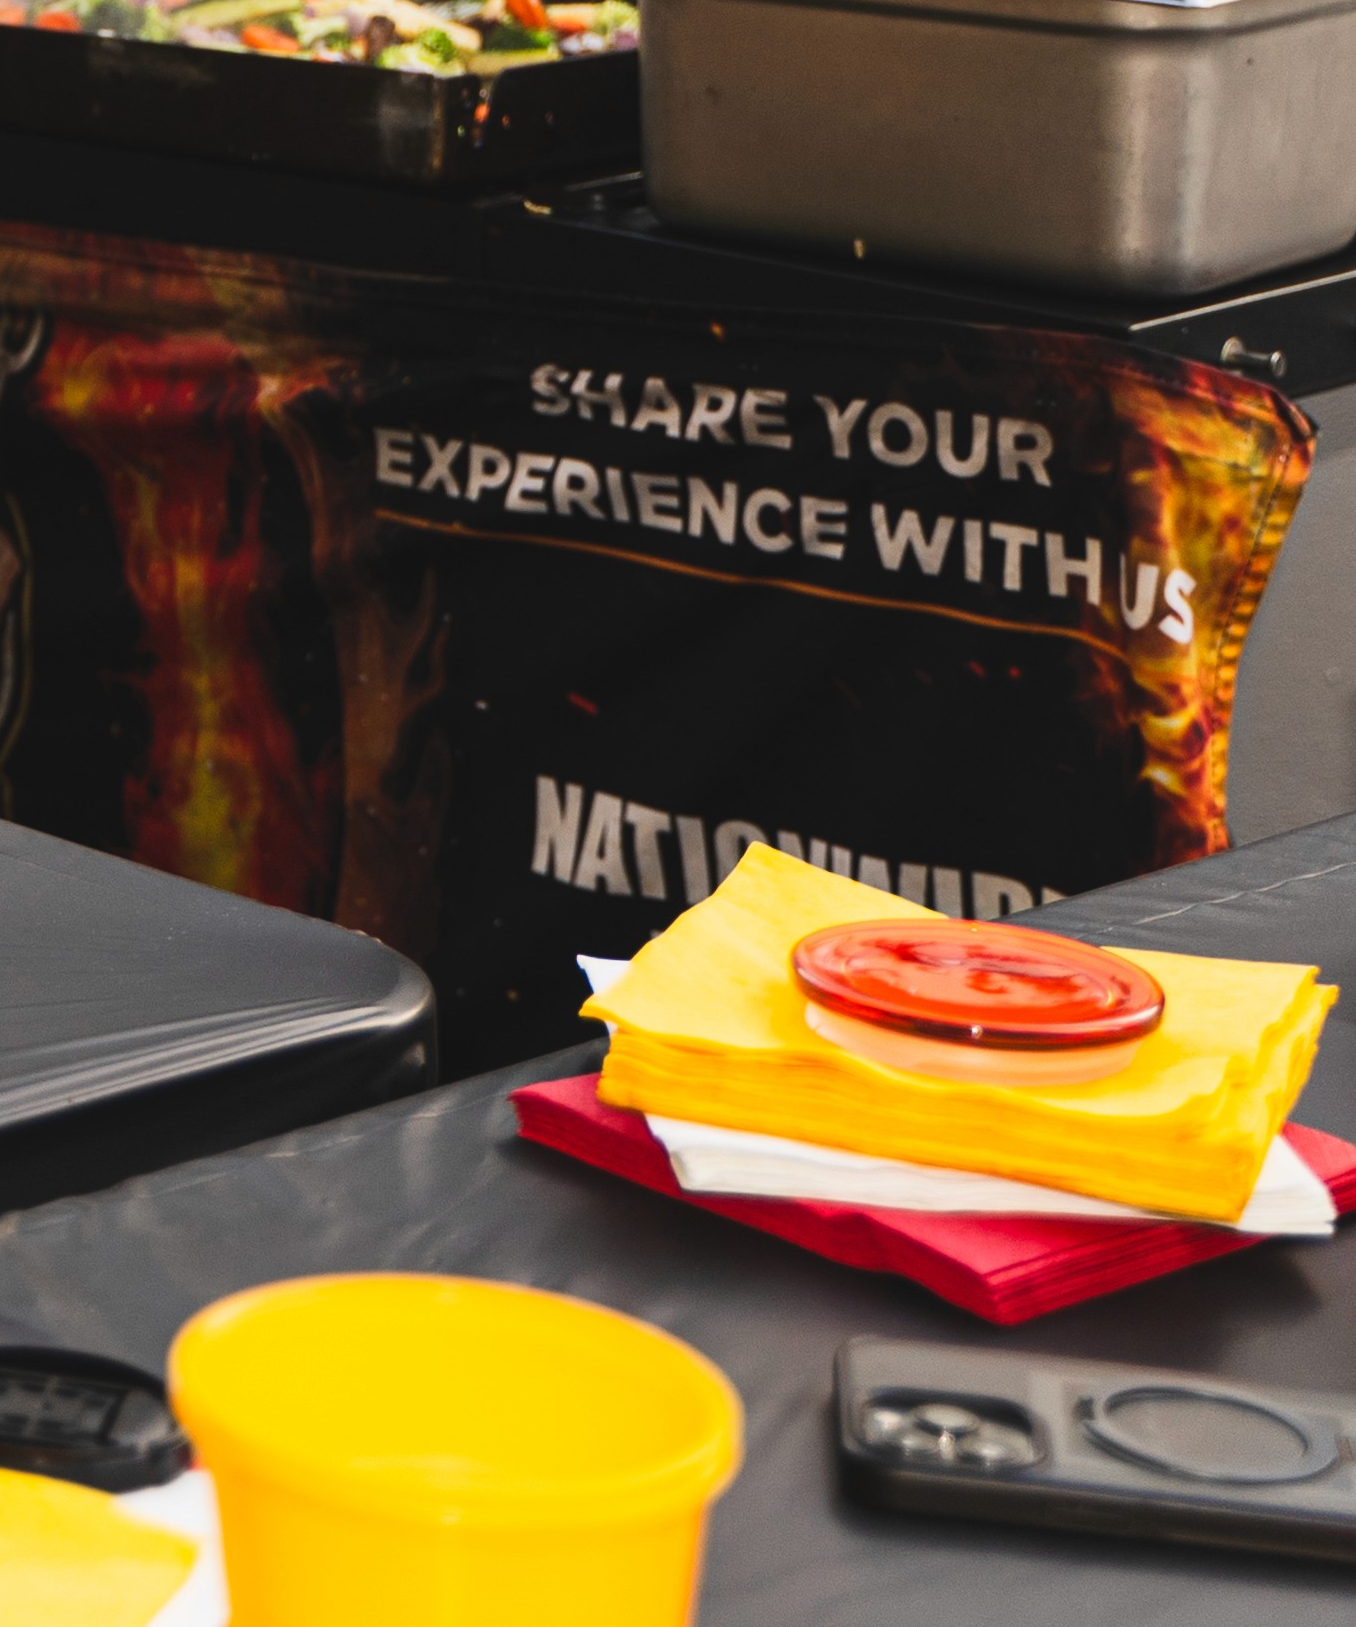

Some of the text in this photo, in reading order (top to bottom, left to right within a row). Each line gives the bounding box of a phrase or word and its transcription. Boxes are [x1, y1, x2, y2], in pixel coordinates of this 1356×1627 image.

[530, 363, 1055, 488] SHARE YOUR
[373, 426, 1198, 645] EXPERIENCE WITH US
